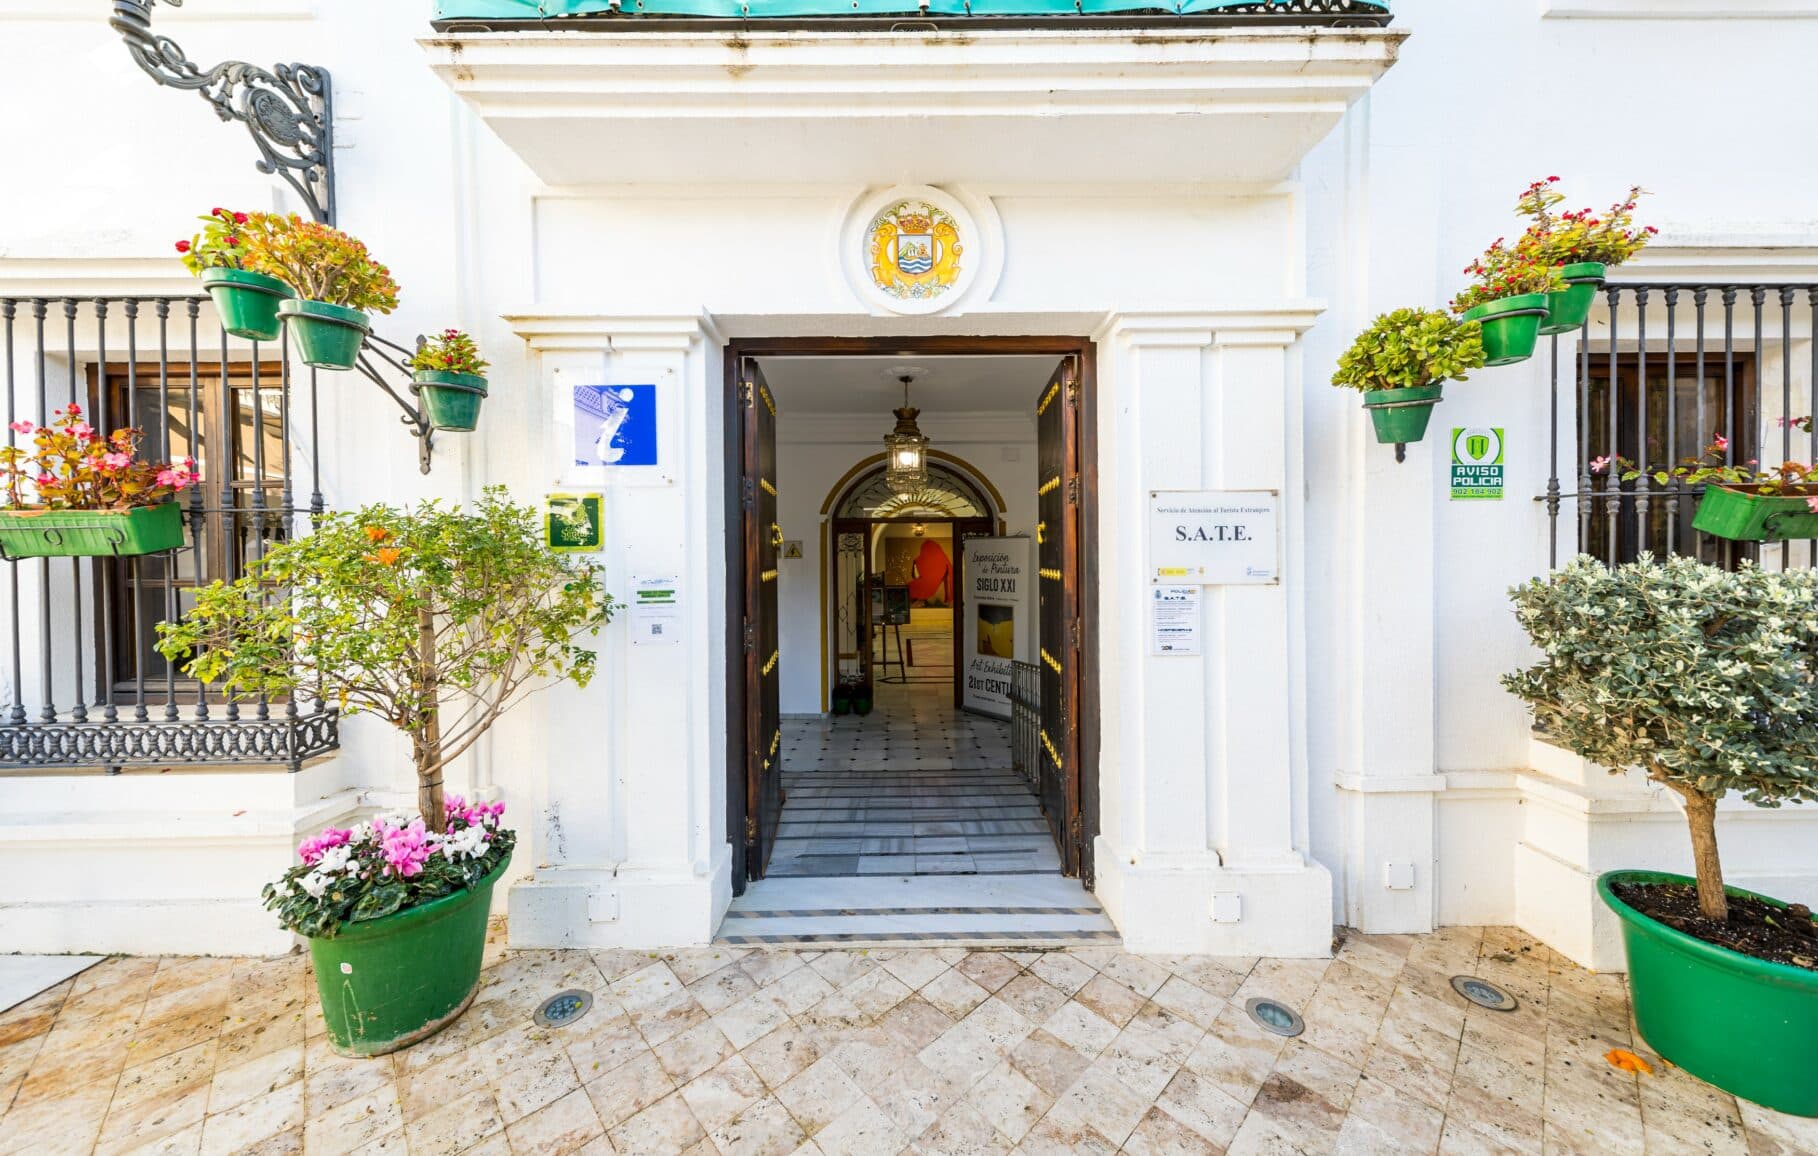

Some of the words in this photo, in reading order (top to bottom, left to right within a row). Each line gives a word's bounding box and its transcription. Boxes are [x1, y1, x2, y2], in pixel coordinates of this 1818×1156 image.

[1457, 466, 1499, 476] AVISO
[1453, 476, 1502, 486] POLICIA
[1241, 506, 1270, 515] Extranjero
[1175, 525, 1252, 541] S.A.T.E.
[972, 552, 1009, 566] Exposición
[991, 562, 1020, 574] Pintura
[976, 577, 998, 591] SIGLO
[1000, 578, 1016, 592] XXI
[970, 659, 984, 671] Art
